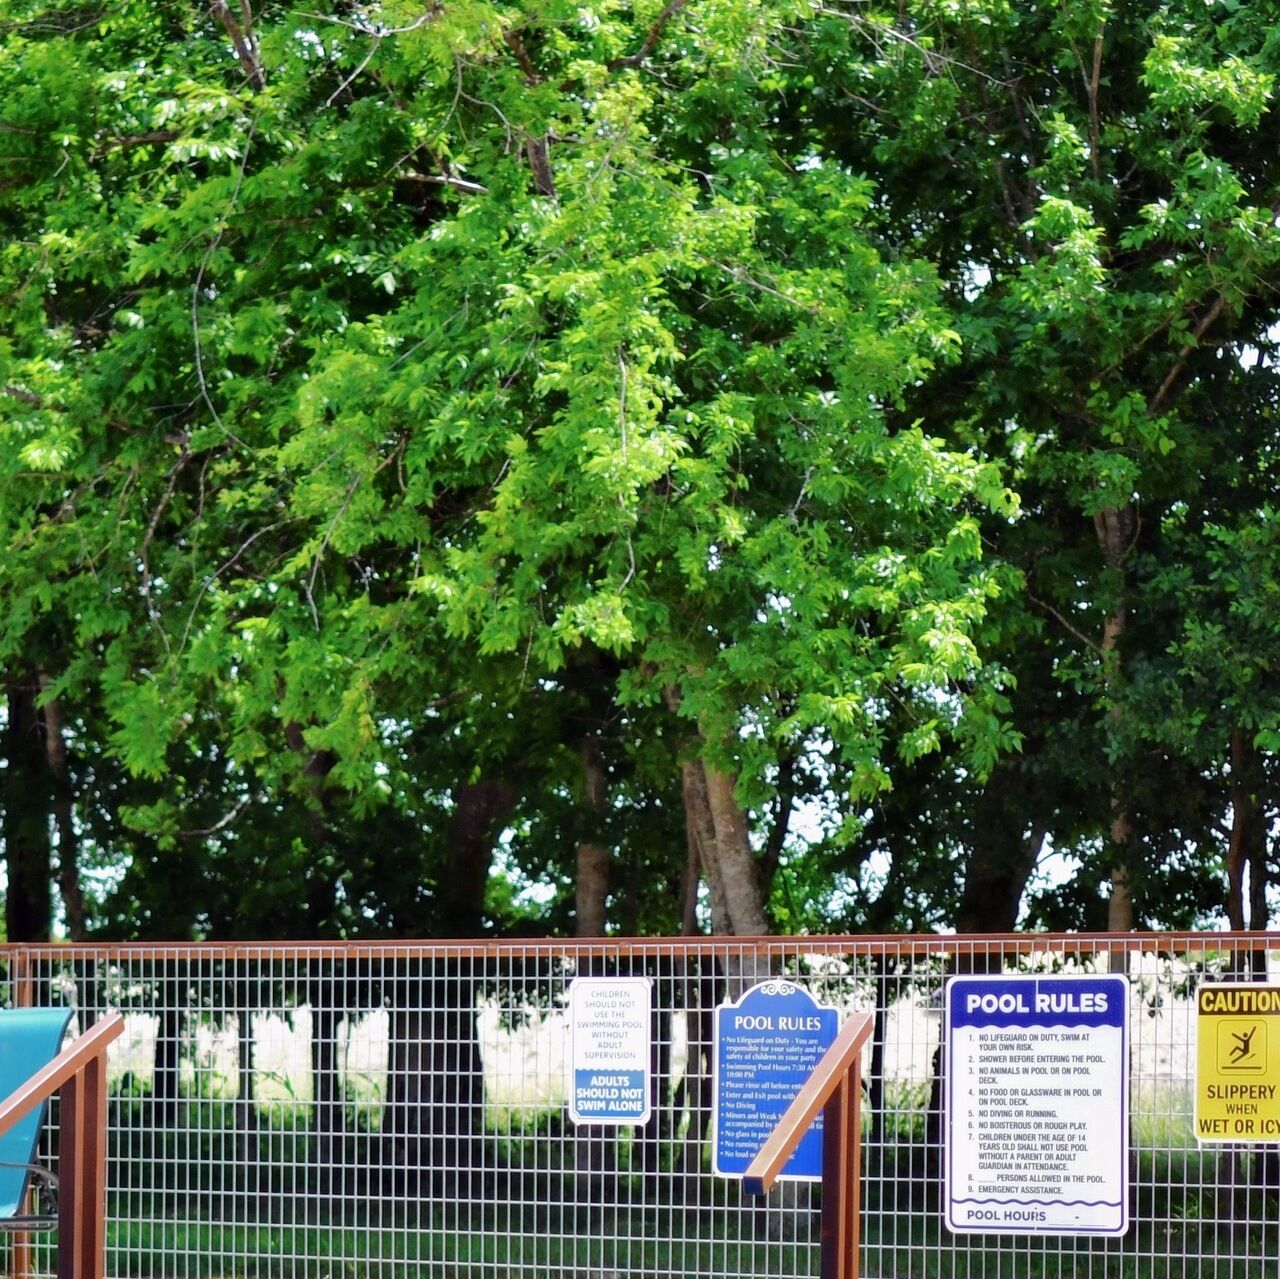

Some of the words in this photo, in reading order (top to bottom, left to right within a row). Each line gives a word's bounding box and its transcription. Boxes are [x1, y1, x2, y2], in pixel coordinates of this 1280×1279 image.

[967, 994, 1029, 1013] POOL
[1035, 993, 1108, 1013] RULES
[735, 1016, 774, 1030] POOL
[779, 1017, 821, 1030] RULES
[591, 1076, 629, 1086] ADULTS
[577, 1088, 618, 1098] SHOULD
[621, 1089, 643, 1099] NOT
[1208, 1085, 1276, 1099] SLIPPERY
[578, 1101, 606, 1110] SWIM
[608, 1101, 642, 1111] ALONE
[1226, 1104, 1257, 1114] WHEN
[1200, 1119, 1229, 1133] WET
[1235, 1119, 1254, 1133] OR
[968, 1211, 1000, 1220] POOL
[1004, 1211, 1046, 1221] HOURS
